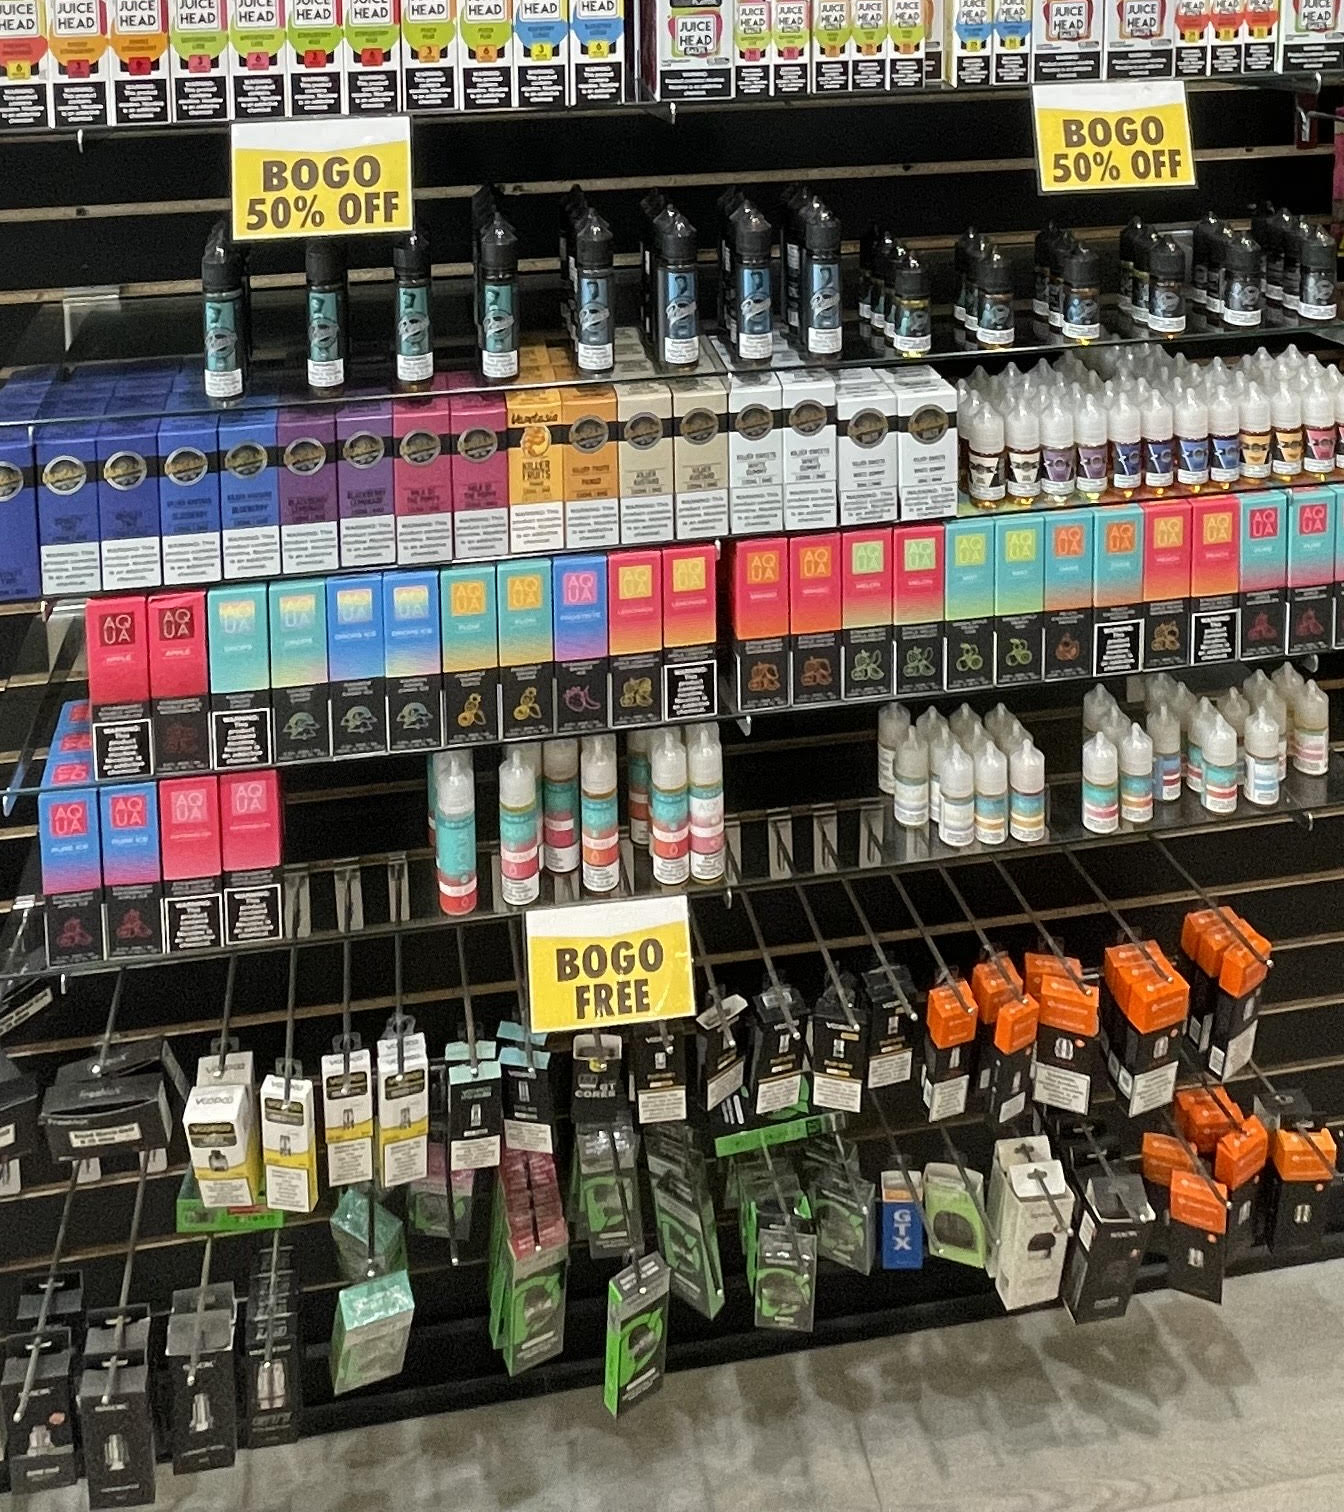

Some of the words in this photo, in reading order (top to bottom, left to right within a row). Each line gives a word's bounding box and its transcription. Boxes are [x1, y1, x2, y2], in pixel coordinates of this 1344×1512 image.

[57, 2, 95, 14] JUICE
[468, 5, 502, 16] HEAD
[582, 0, 615, 12] HEAD
[740, 6, 765, 16] JUICE
[1127, 3, 1156, 15] JUICE
[180, 12, 216, 24] HEAD
[354, 6, 389, 19] HEAD
[57, 17, 95, 29] HEAD
[741, 17, 766, 27] HEAD
[1127, 17, 1157, 28] HEAD
[1063, 115, 1165, 148] BOGO
[1053, 149, 1121, 182] 50%
[1130, 145, 1182, 179] OFF
[261, 156, 382, 193] BOGO
[245, 192, 325, 232] 50%
[338, 190, 400, 226] OFF
[555, 937, 664, 983] BOGO
[575, 979, 652, 1020] FREE
[892, 1208, 911, 1252] GTX
